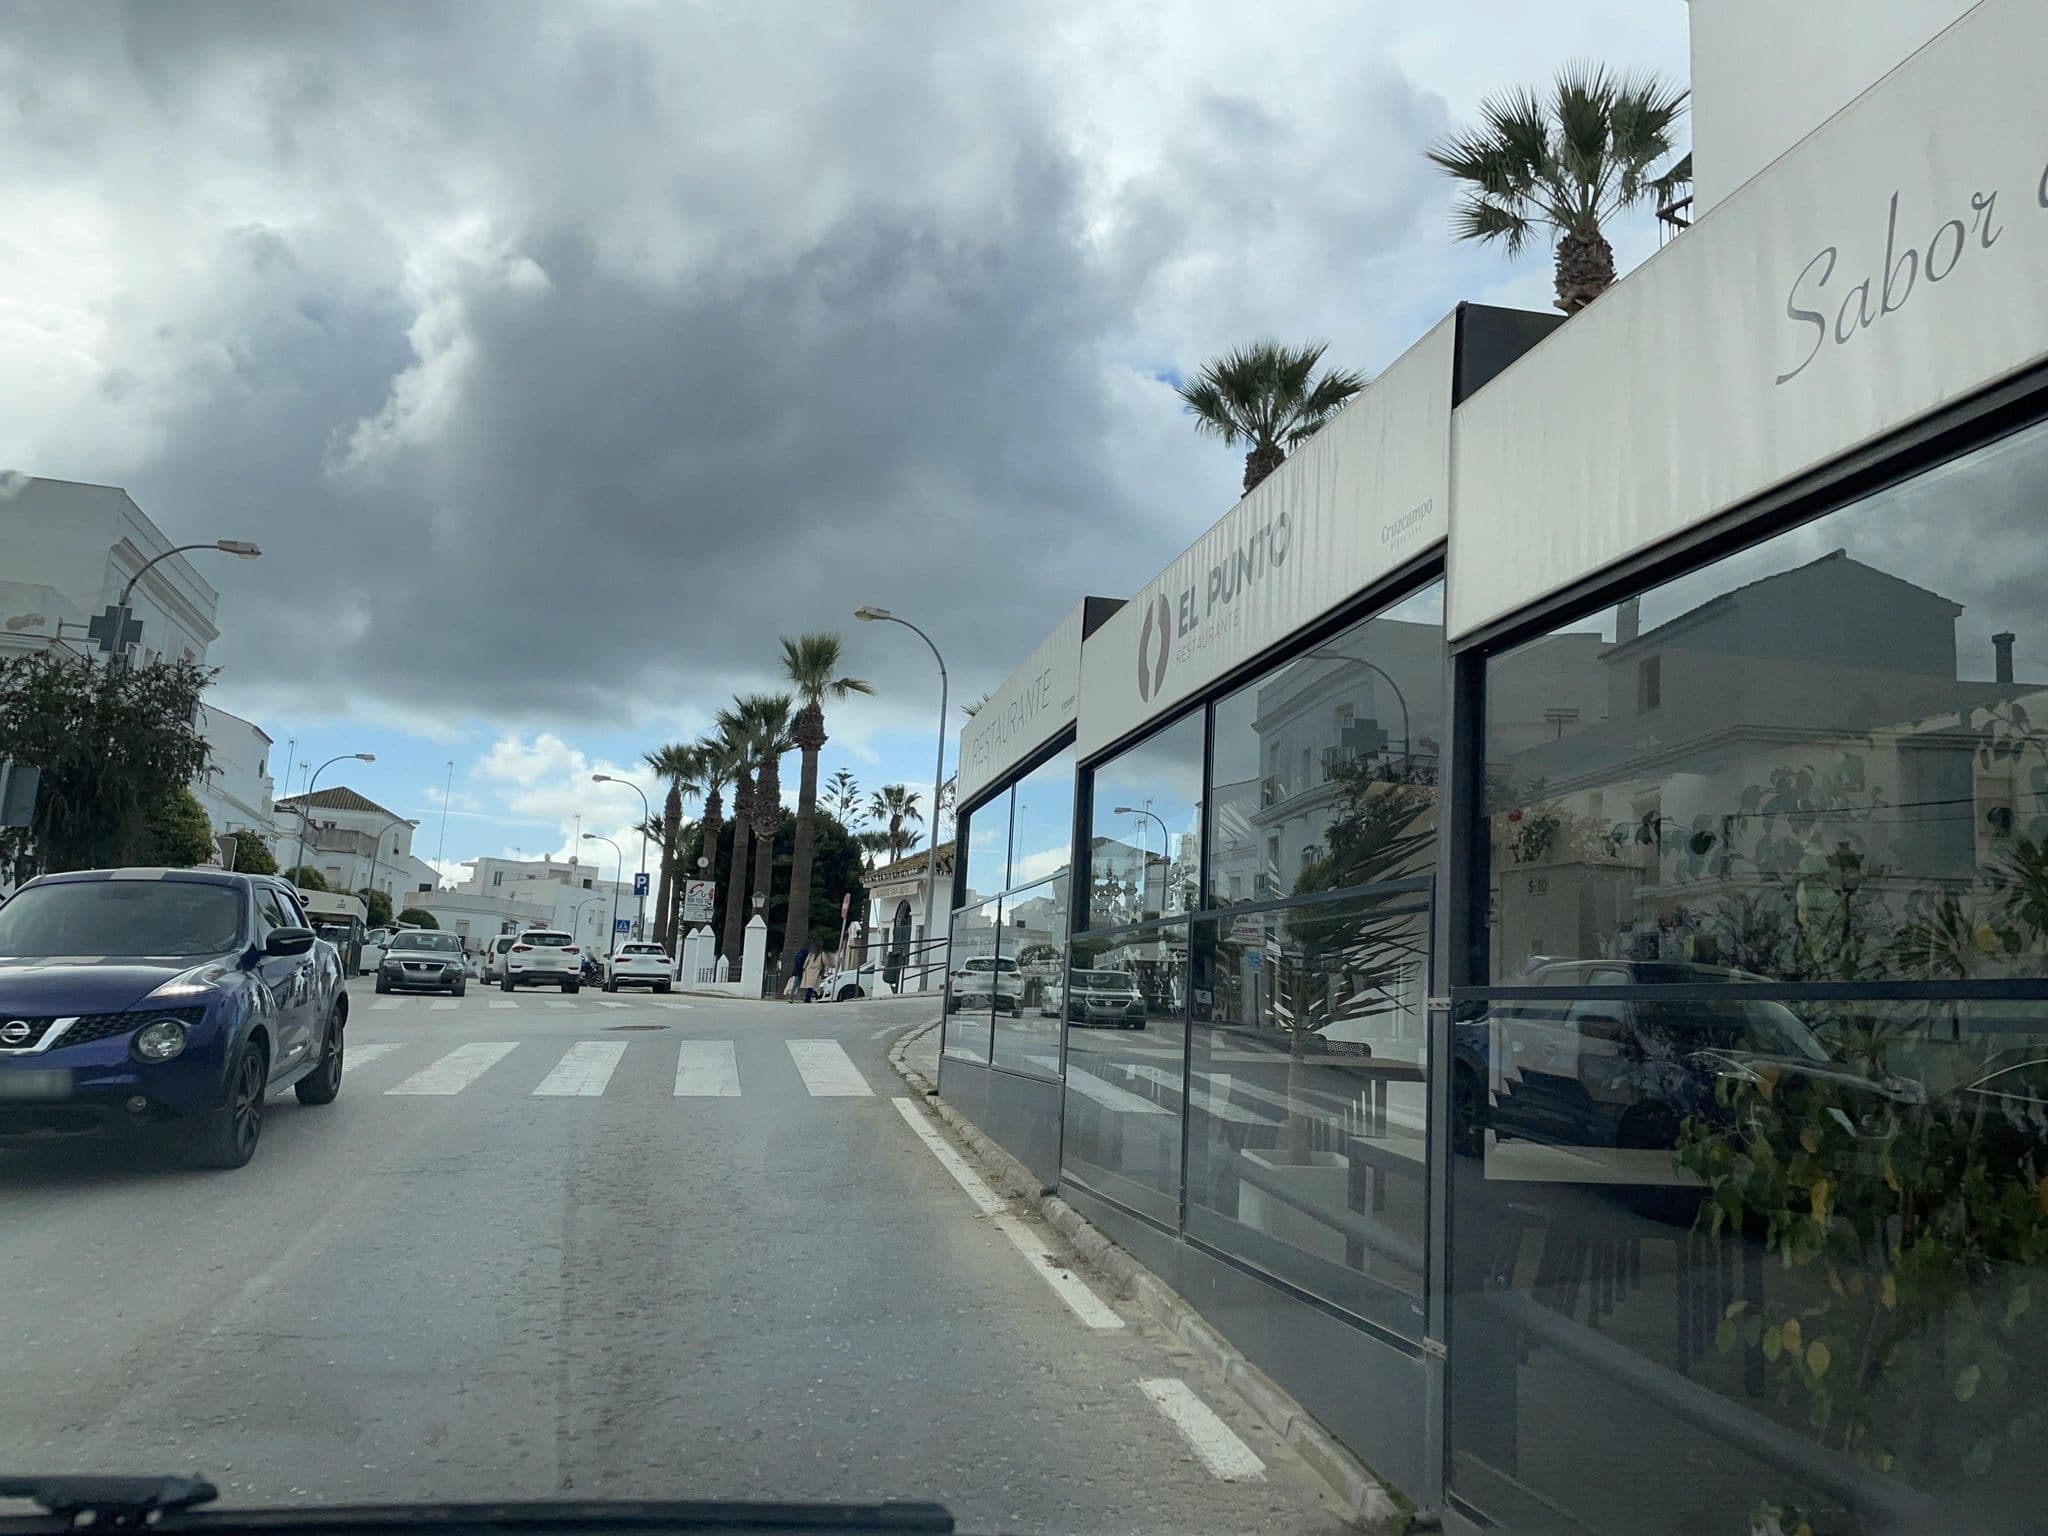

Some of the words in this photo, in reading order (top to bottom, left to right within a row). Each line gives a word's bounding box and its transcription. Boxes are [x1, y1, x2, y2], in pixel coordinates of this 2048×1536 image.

[1775, 189, 2004, 386] Sabor
[1381, 498, 1433, 544] Cruzcampo
[1178, 583, 1200, 640] EL
[1206, 511, 1291, 618] PUNTO
[1175, 607, 1241, 665] RESTAURANTE
[969, 667, 1052, 772] RESTAURANTE
